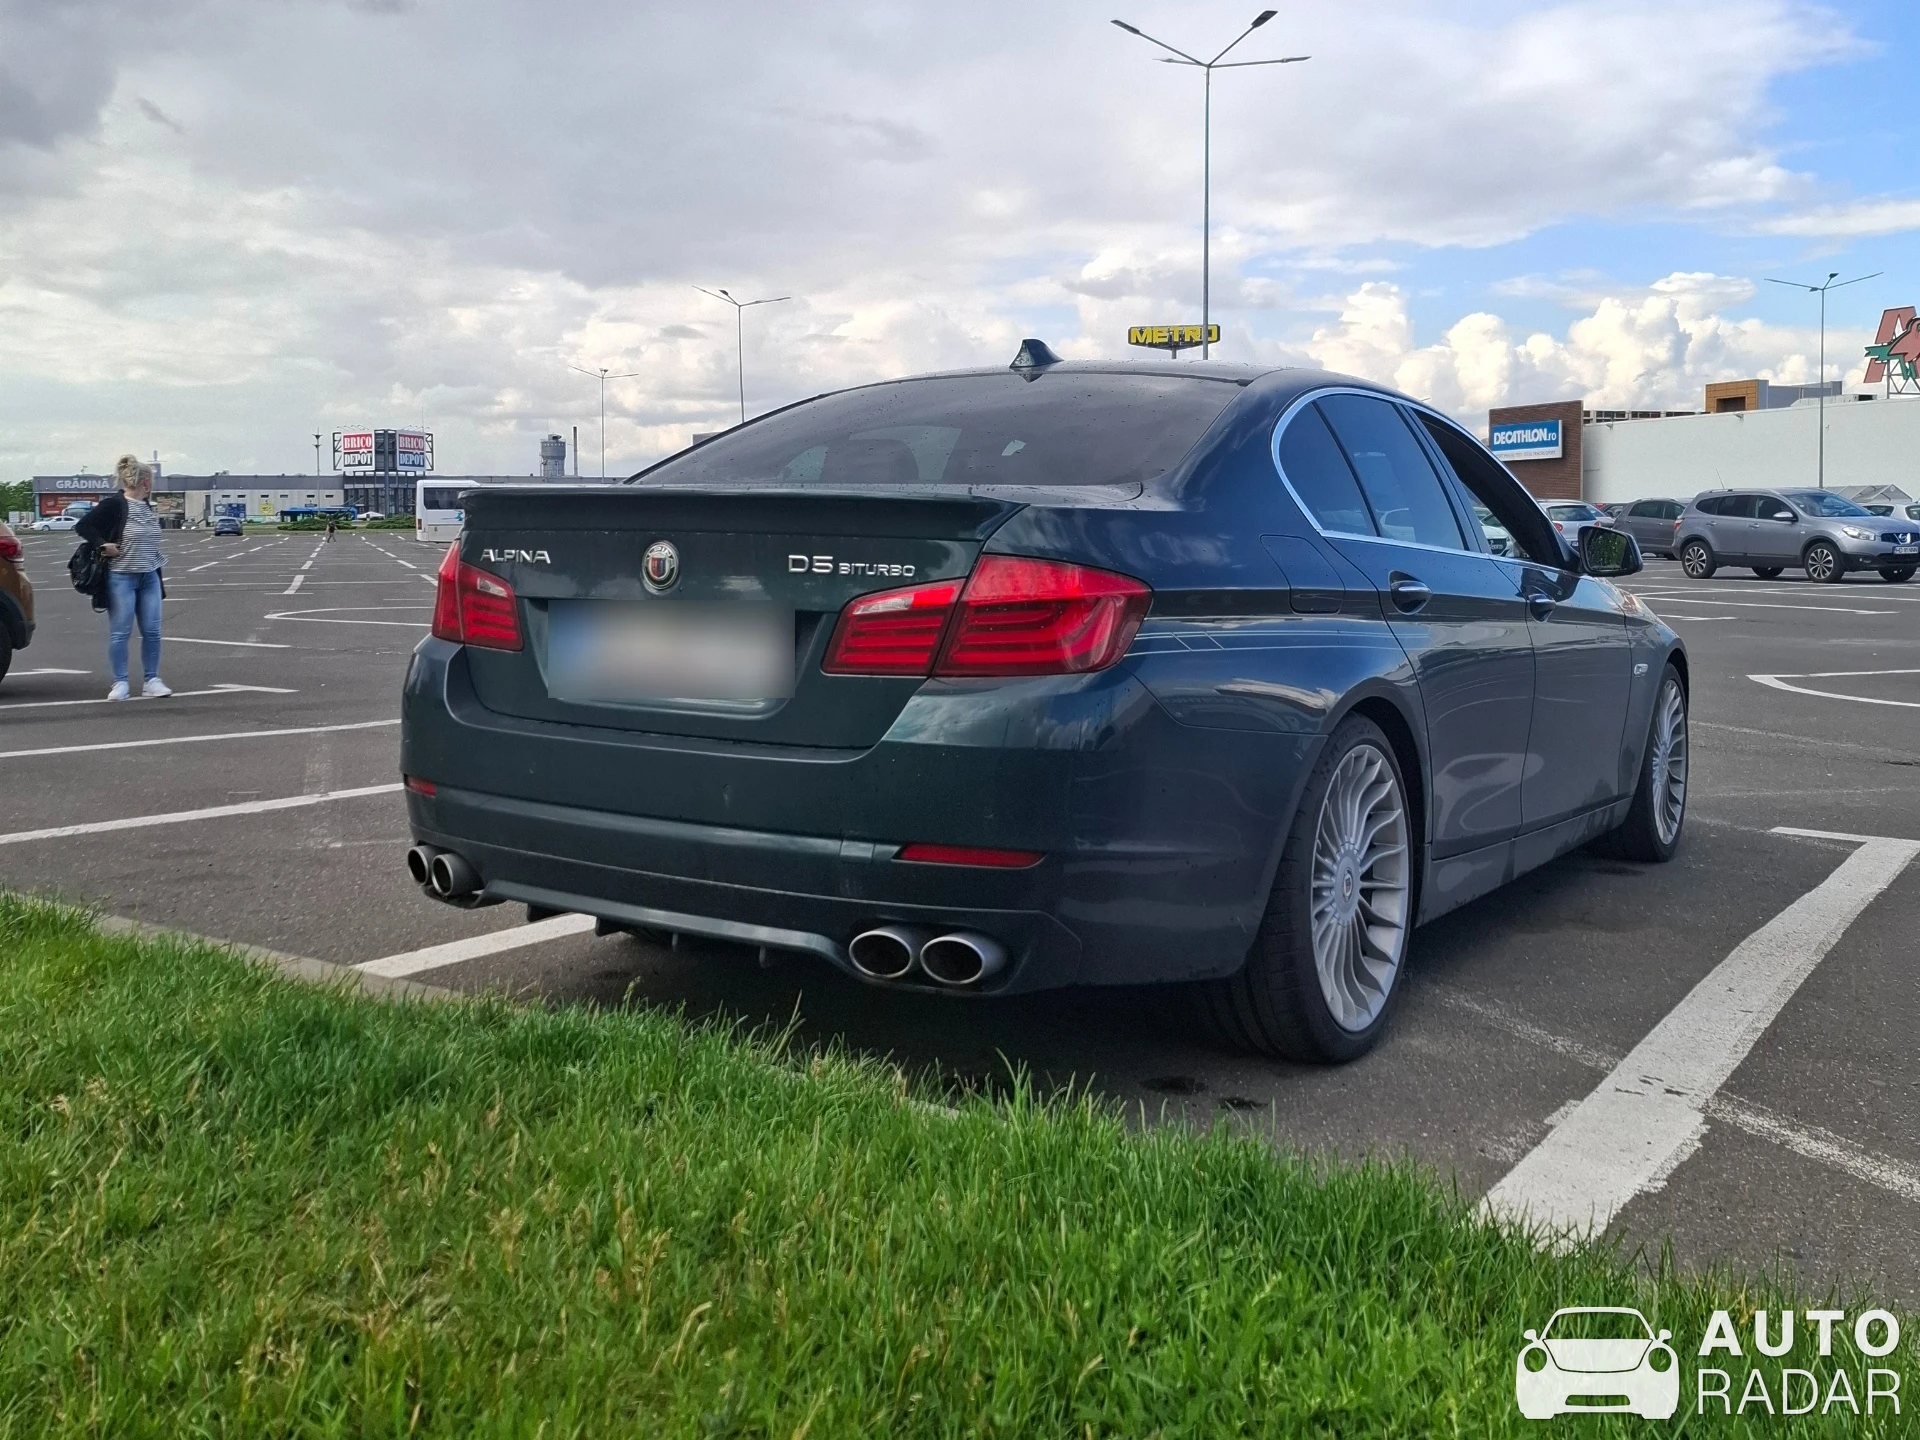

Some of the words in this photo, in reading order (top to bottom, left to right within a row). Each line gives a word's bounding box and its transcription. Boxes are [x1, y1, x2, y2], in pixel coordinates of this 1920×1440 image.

[1130, 325, 1218, 343] METRO
[344, 436, 372, 449] BRICO
[399, 436, 424, 449] BRICO
[480, 549, 551, 564] ALPINA
[788, 555, 834, 573] D5
[838, 562, 916, 577] BITURBO
